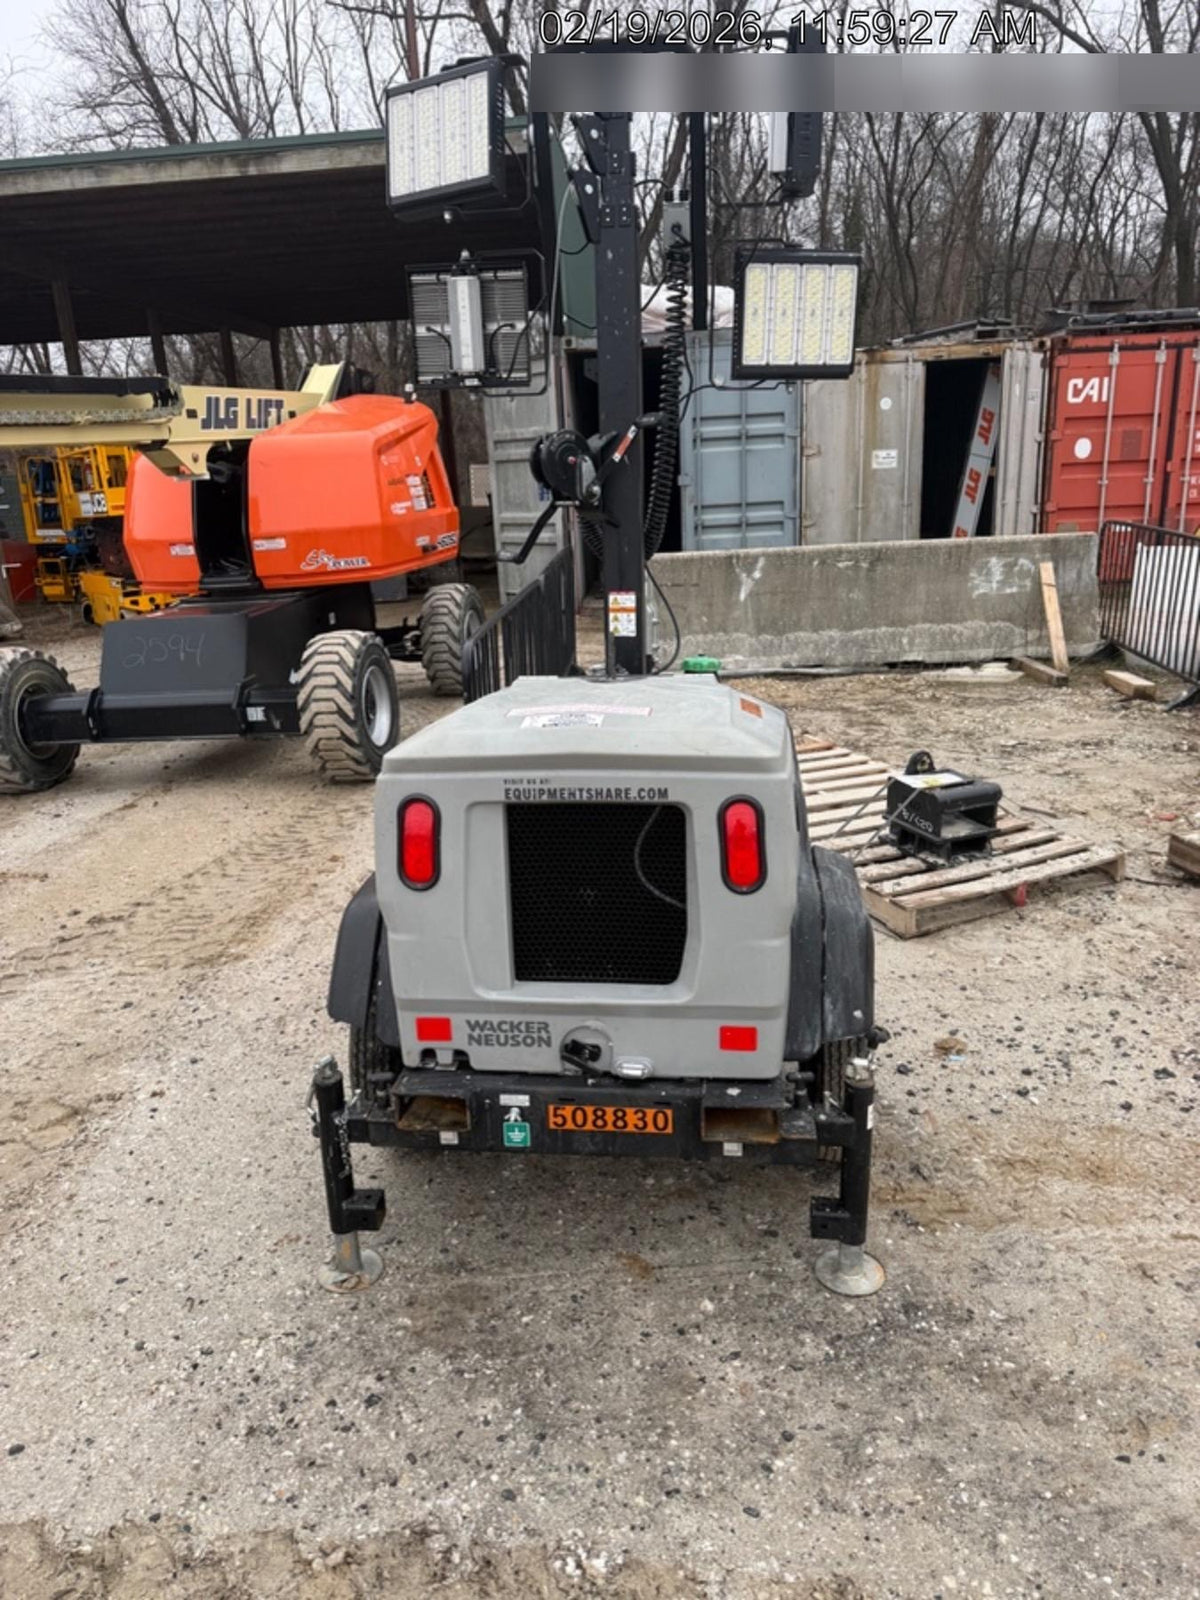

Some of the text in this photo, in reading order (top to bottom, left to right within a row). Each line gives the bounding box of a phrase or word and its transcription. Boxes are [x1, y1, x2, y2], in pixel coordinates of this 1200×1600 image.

[1067, 376, 1110, 404] CAI
[200, 395, 285, 430] JLG LIFT
[977, 407, 996, 446] JLG
[963, 467, 982, 505] JLG
[122, 633, 206, 669] 2594
[504, 787, 669, 800] EQUIPMENTSHARE.COM
[465, 1019, 550, 1034] WACKER
[467, 1033, 552, 1048] NEUSON
[551, 1106, 670, 1132] 508830
